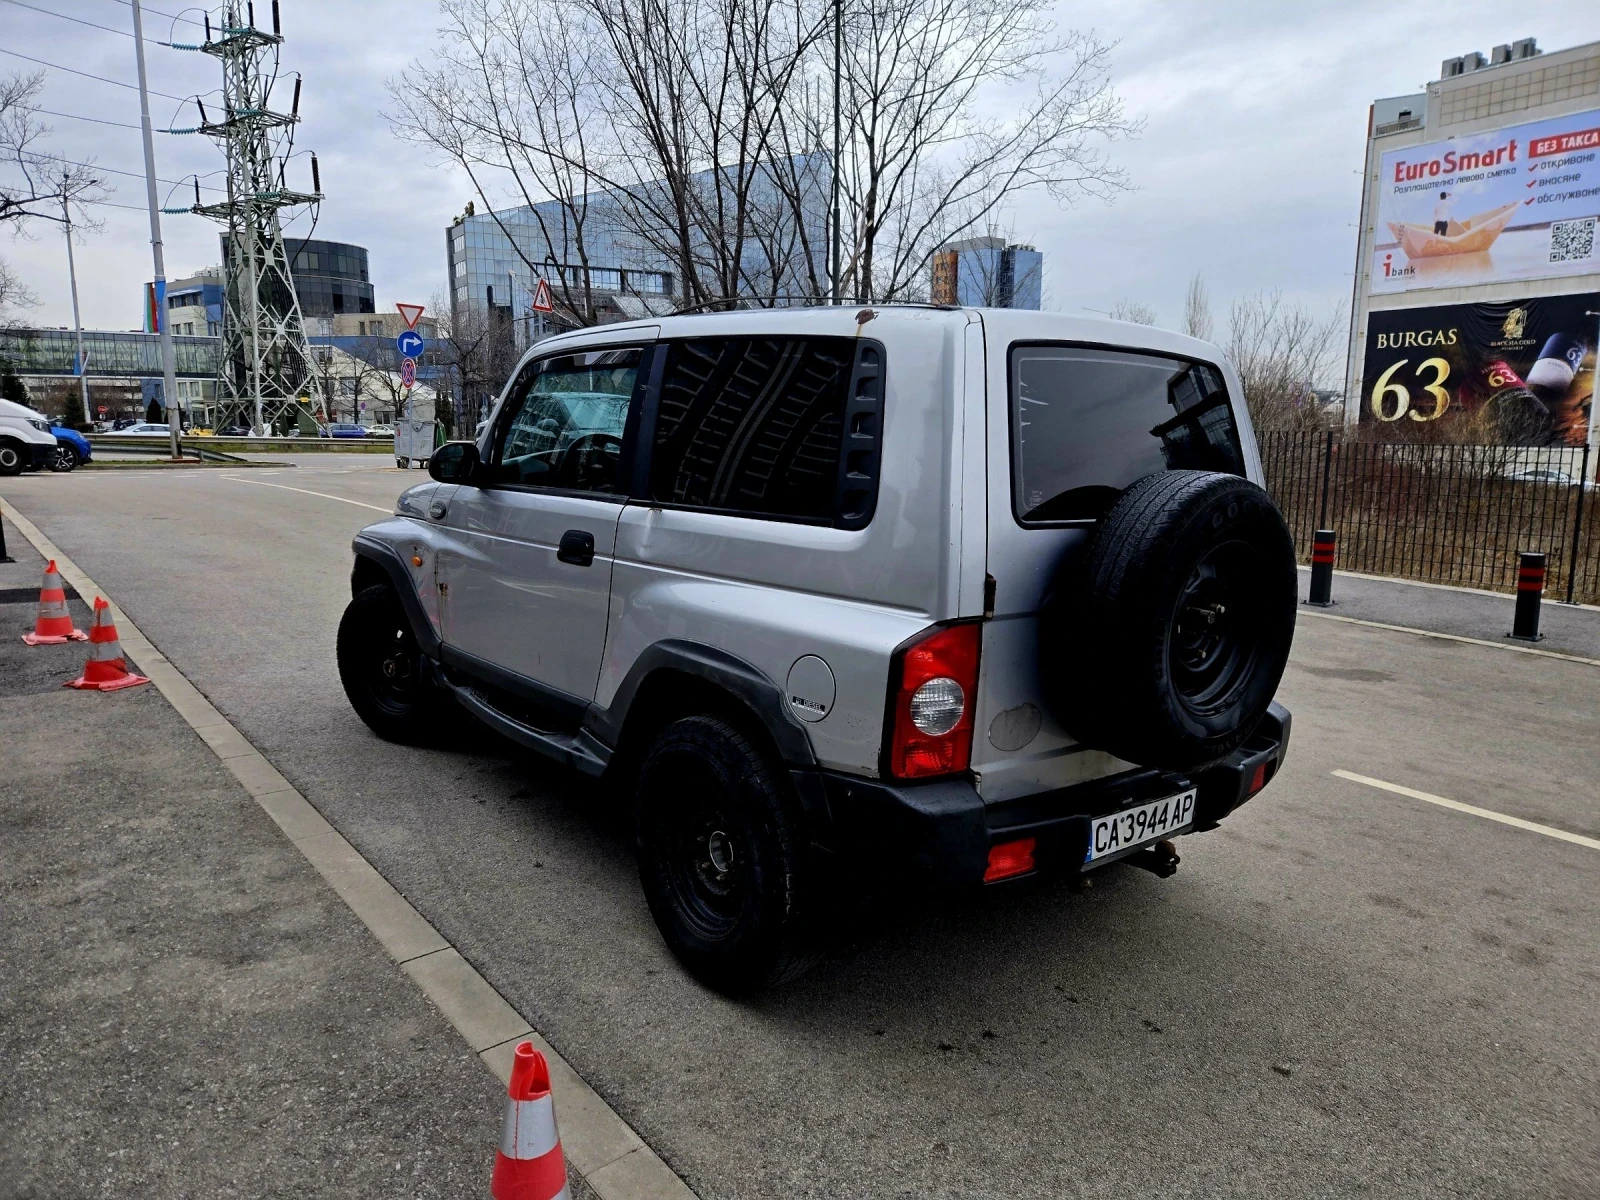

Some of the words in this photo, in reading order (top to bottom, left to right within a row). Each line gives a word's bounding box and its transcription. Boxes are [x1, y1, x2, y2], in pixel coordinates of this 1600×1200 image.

[1537, 140, 1557, 154] БЕЗ
[1561, 132, 1599, 149] ТАКСА
[1395, 139, 1518, 183] EuroSmart
[1540, 153, 1596, 169] откриване
[1394, 178, 1454, 194] Разплащателна
[1455, 173, 1485, 184] левова
[1486, 167, 1517, 179] сметка
[1539, 173, 1582, 187] внасяне
[1537, 187, 1600, 203] обслужване
[1376, 328, 1458, 349] BURGAS
[1566, 347, 1583, 367] 63
[1488, 369, 1518, 388] 63
[1371, 357, 1451, 422] 63
